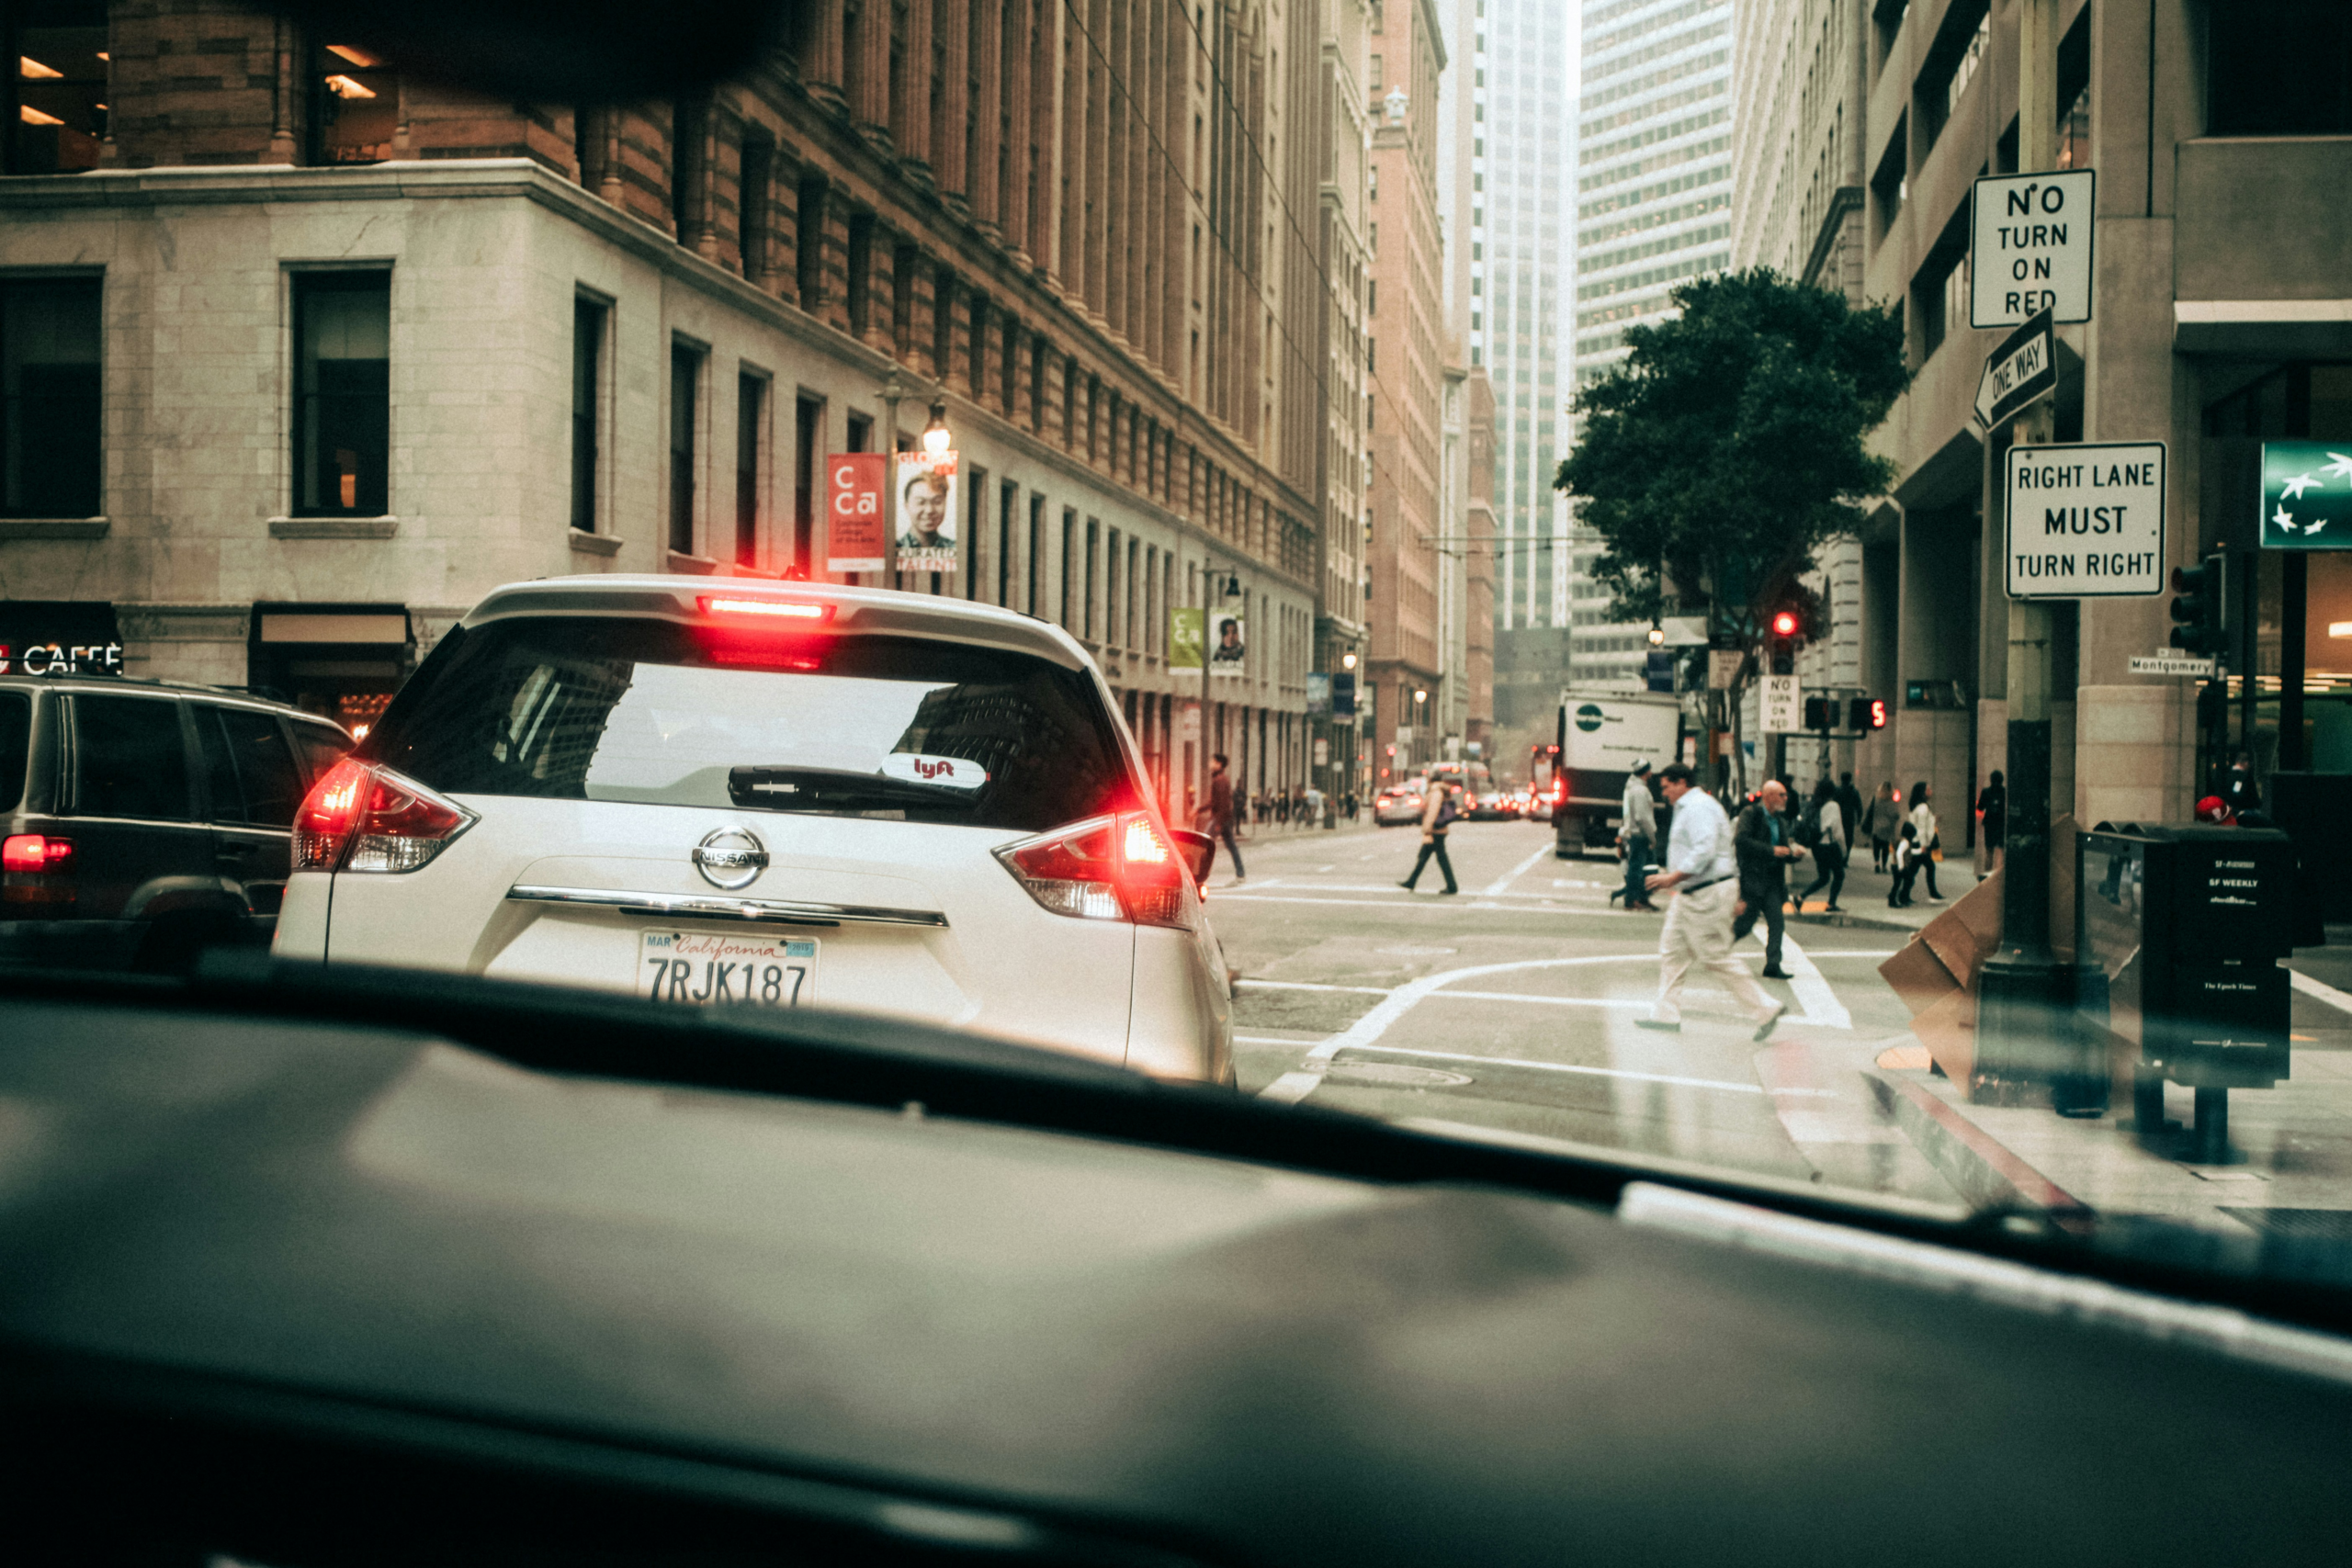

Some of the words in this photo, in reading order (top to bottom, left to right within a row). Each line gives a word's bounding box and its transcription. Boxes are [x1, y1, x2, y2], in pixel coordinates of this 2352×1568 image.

[2007, 186, 2064, 217] NO
[1997, 223, 2067, 250] TURN
[2013, 257, 2051, 281] ON
[2006, 289, 2056, 315] RED
[1993, 361, 2012, 400] ONE
[2016, 339, 2041, 381] WAY
[835, 466, 854, 489] C
[2018, 465, 2085, 490] RIGHT
[2092, 463, 2155, 488] LANE
[2044, 506, 2128, 536] MUST
[2016, 554, 2075, 578] TURN
[2086, 552, 2155, 576] RIGHT
[2132, 660, 2211, 674] Montgomery
[1770, 680, 1792, 691] NO
[1768, 694, 1792, 703] TURN
[1771, 705, 1786, 716] ON
[1770, 718, 1789, 729] RED
[914, 758, 955, 779] lyft
[699, 851, 763, 864] NISSAN
[2222, 879, 2258, 888] WEEKLY
[647, 936, 672, 947] MAR
[676, 936, 786, 962] California
[648, 957, 807, 1007] 7RJK187
